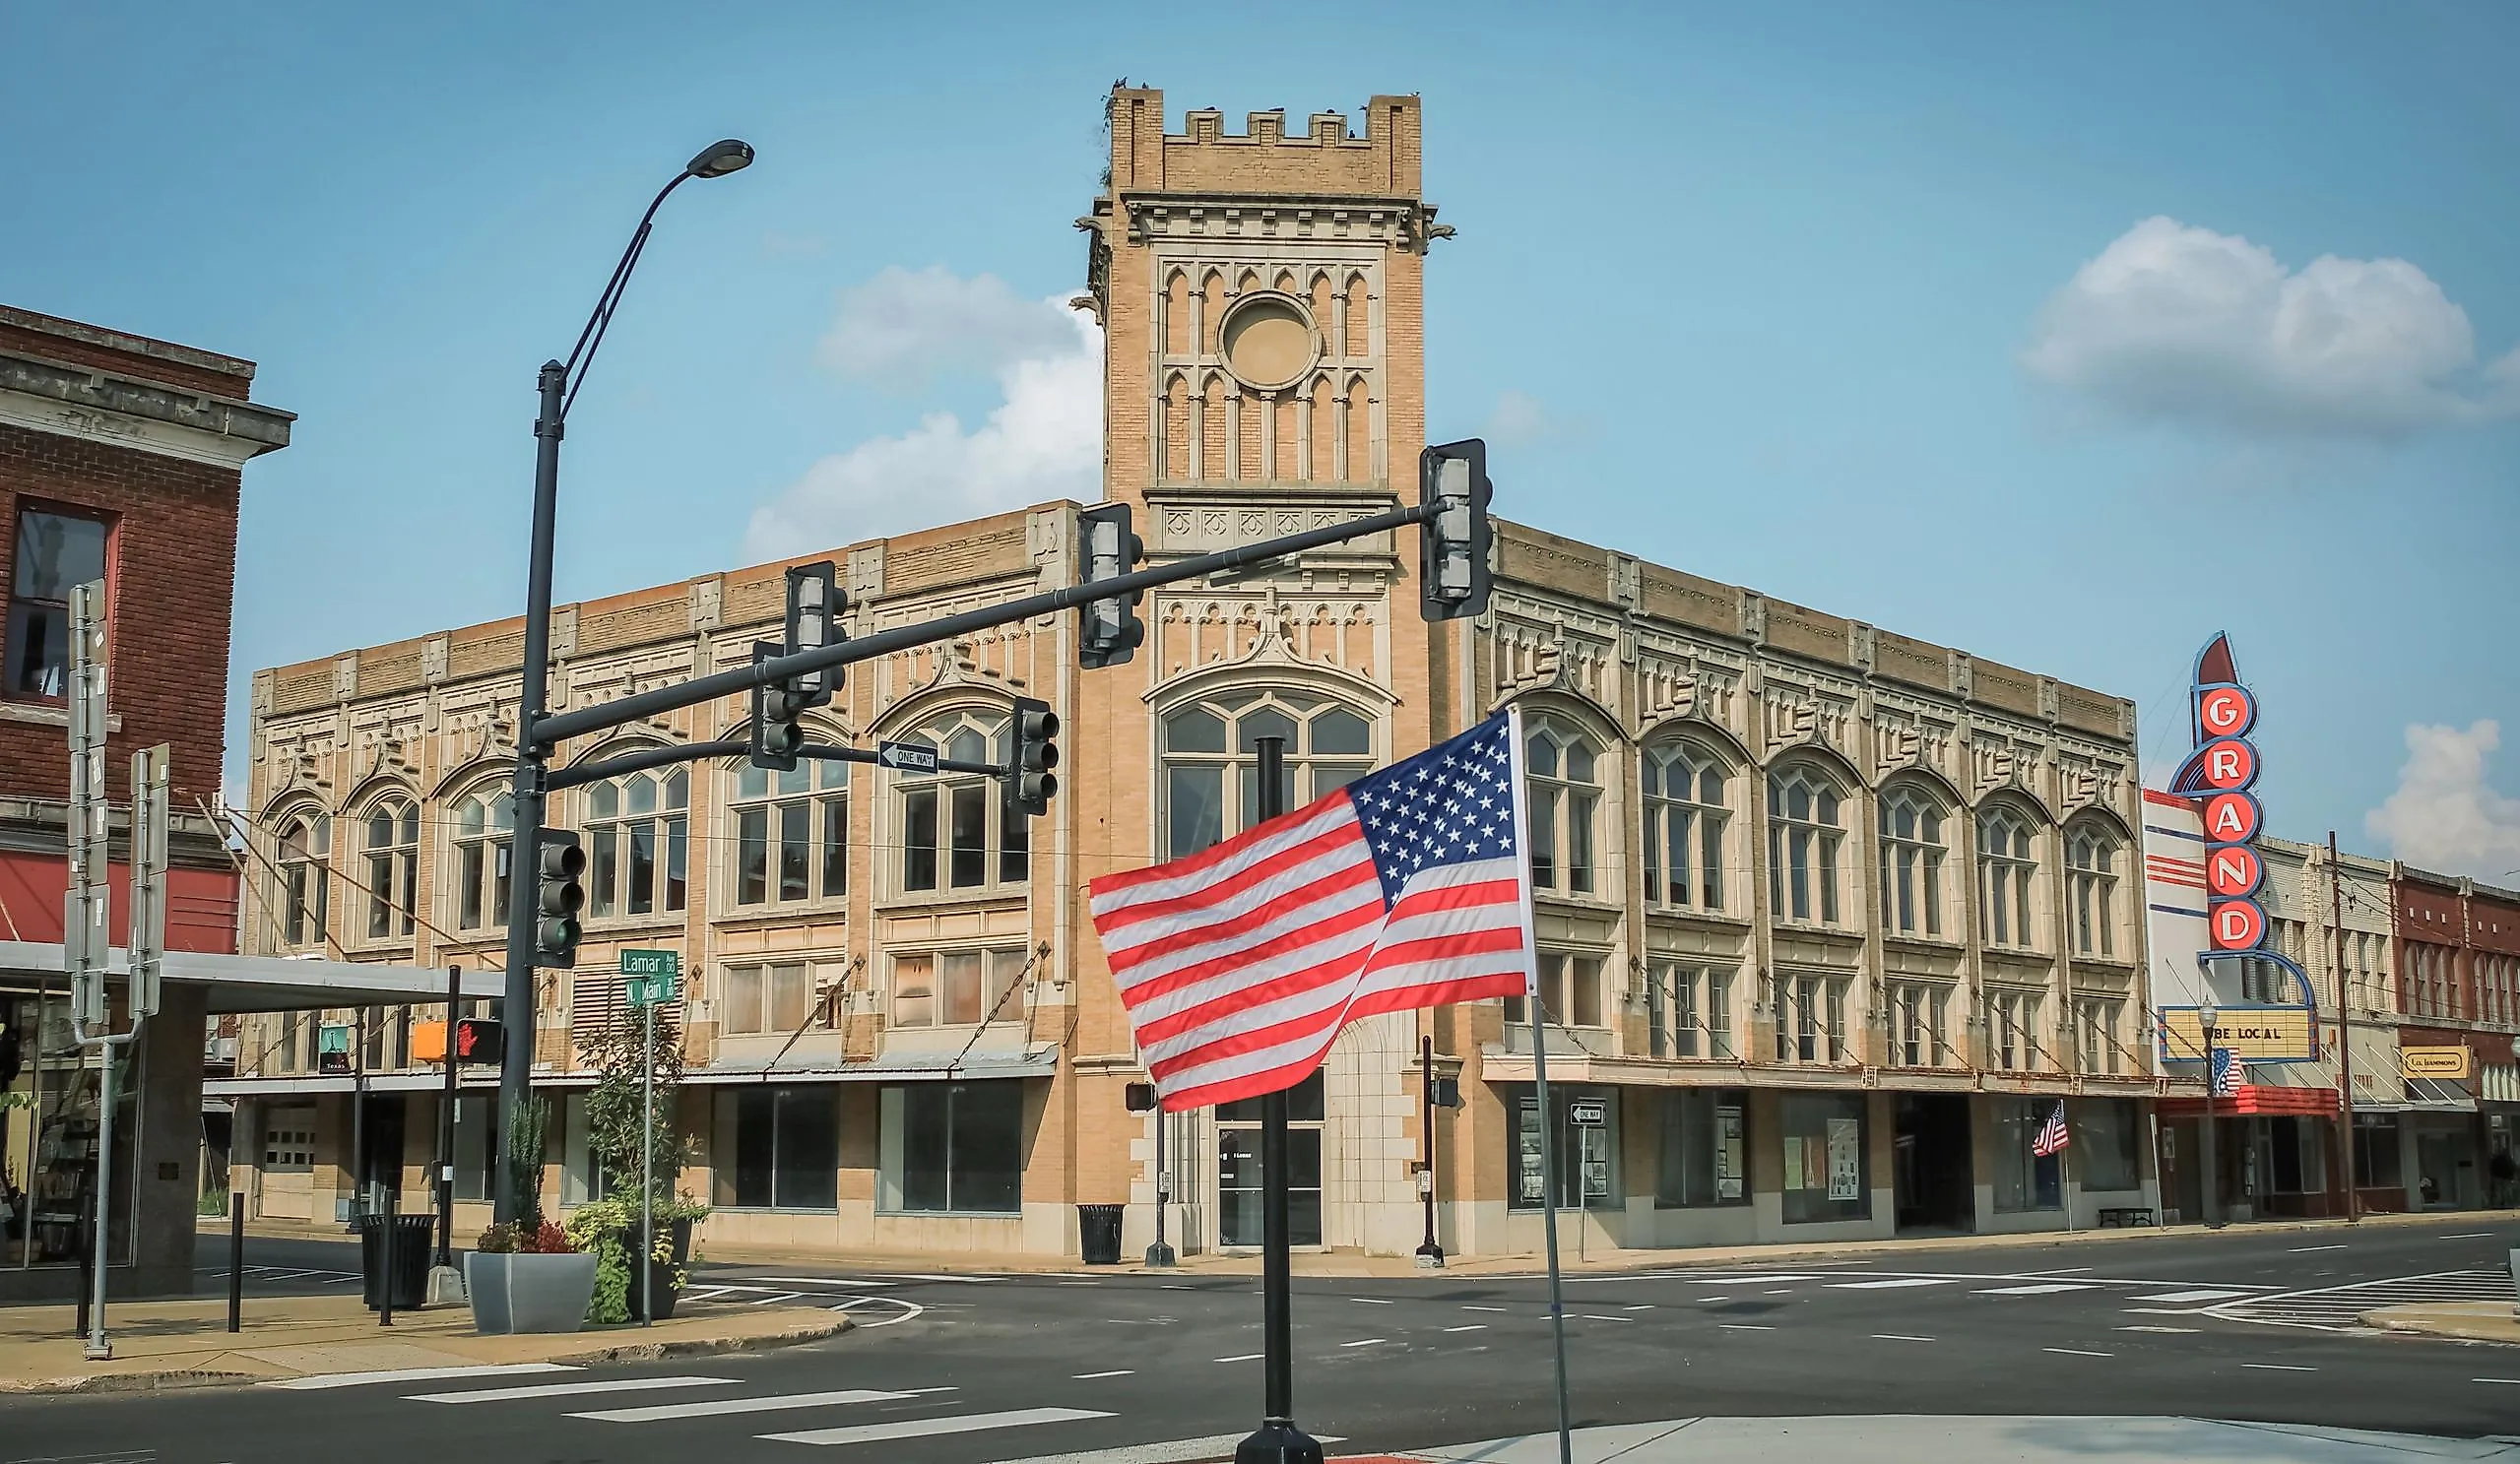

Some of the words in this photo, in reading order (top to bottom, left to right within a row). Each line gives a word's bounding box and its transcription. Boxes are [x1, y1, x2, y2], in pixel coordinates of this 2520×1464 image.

[898, 751, 915, 763] ONE
[916, 753, 933, 766] WAY
[2209, 697, 2250, 941] GRAND
[623, 952, 661, 973] Lamar
[626, 984, 636, 1002] N.
[641, 981, 662, 1000] Main
[2214, 1028, 2230, 1040] BE
[2238, 1028, 2282, 1040] LOCAL
